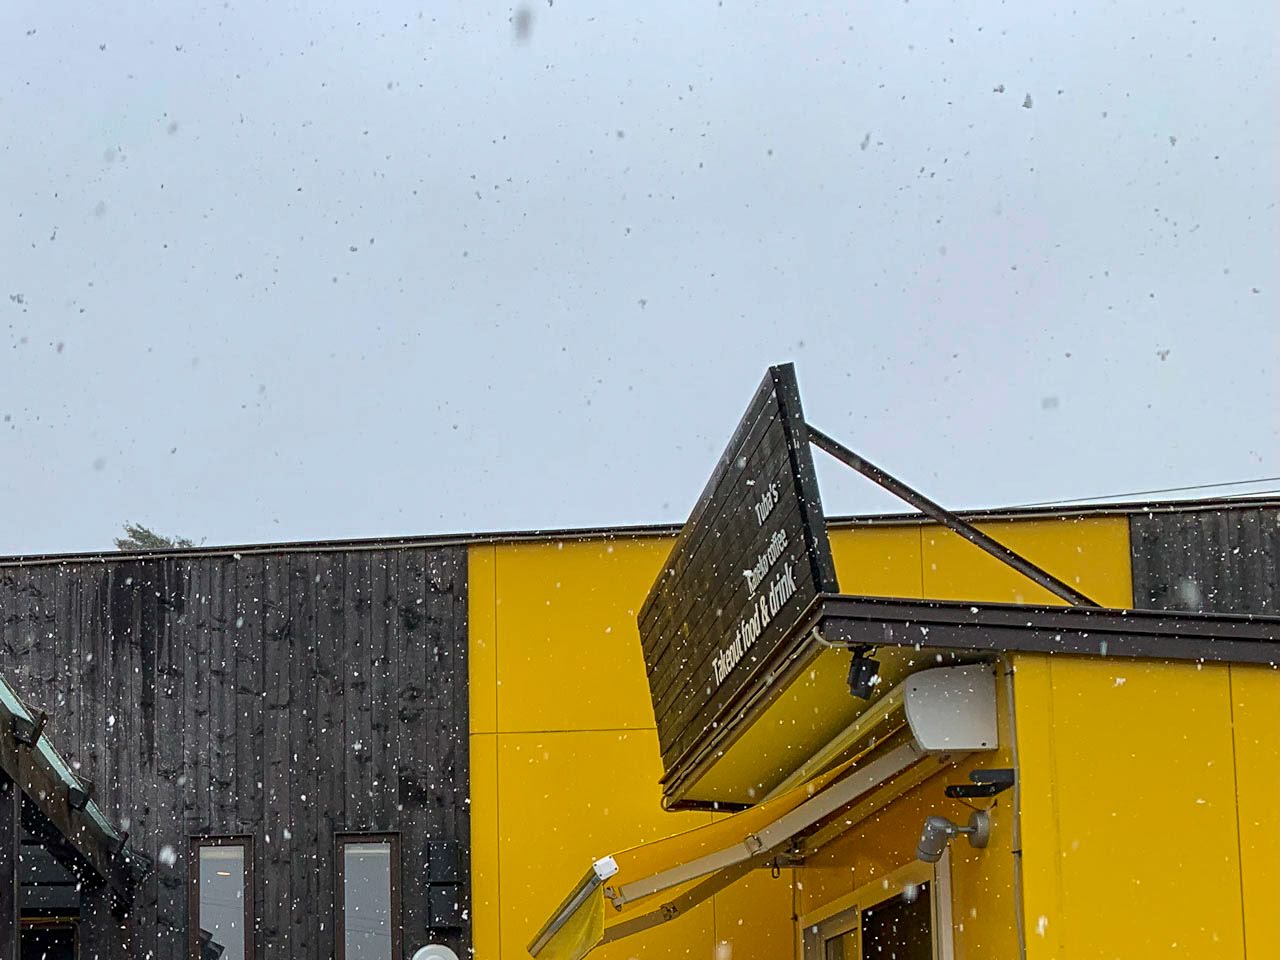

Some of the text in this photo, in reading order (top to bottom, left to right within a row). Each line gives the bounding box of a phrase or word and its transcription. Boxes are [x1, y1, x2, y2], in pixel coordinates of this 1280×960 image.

[755, 483, 779, 526] Tuba's
[767, 529, 788, 566] coffee
[712, 562, 797, 686] Takeout food & drink
